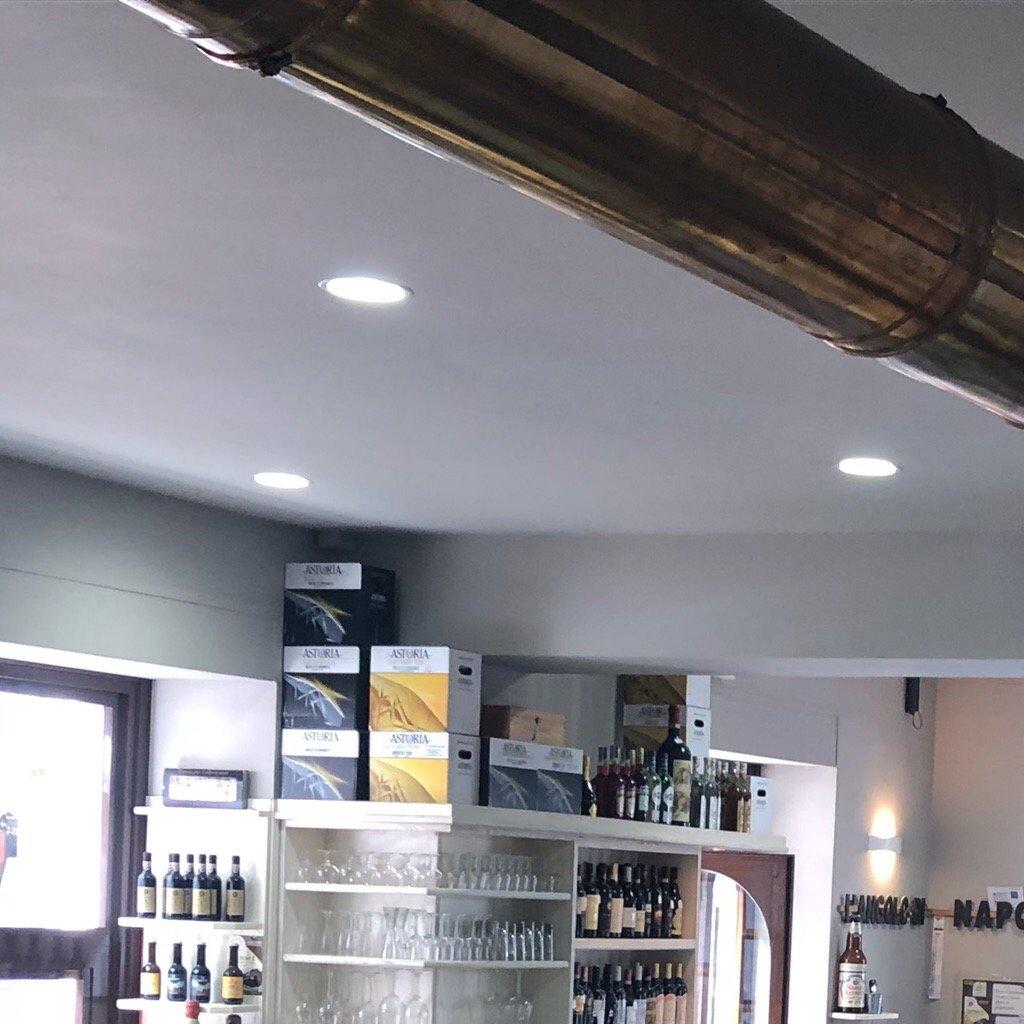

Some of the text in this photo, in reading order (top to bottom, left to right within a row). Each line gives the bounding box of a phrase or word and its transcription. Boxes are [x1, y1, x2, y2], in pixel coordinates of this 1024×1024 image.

[303, 648, 341, 658] ASTORIA
[391, 649, 430, 659] ASTORIA
[303, 732, 339, 742] ASTORIA
[391, 733, 430, 744] ASTORIA
